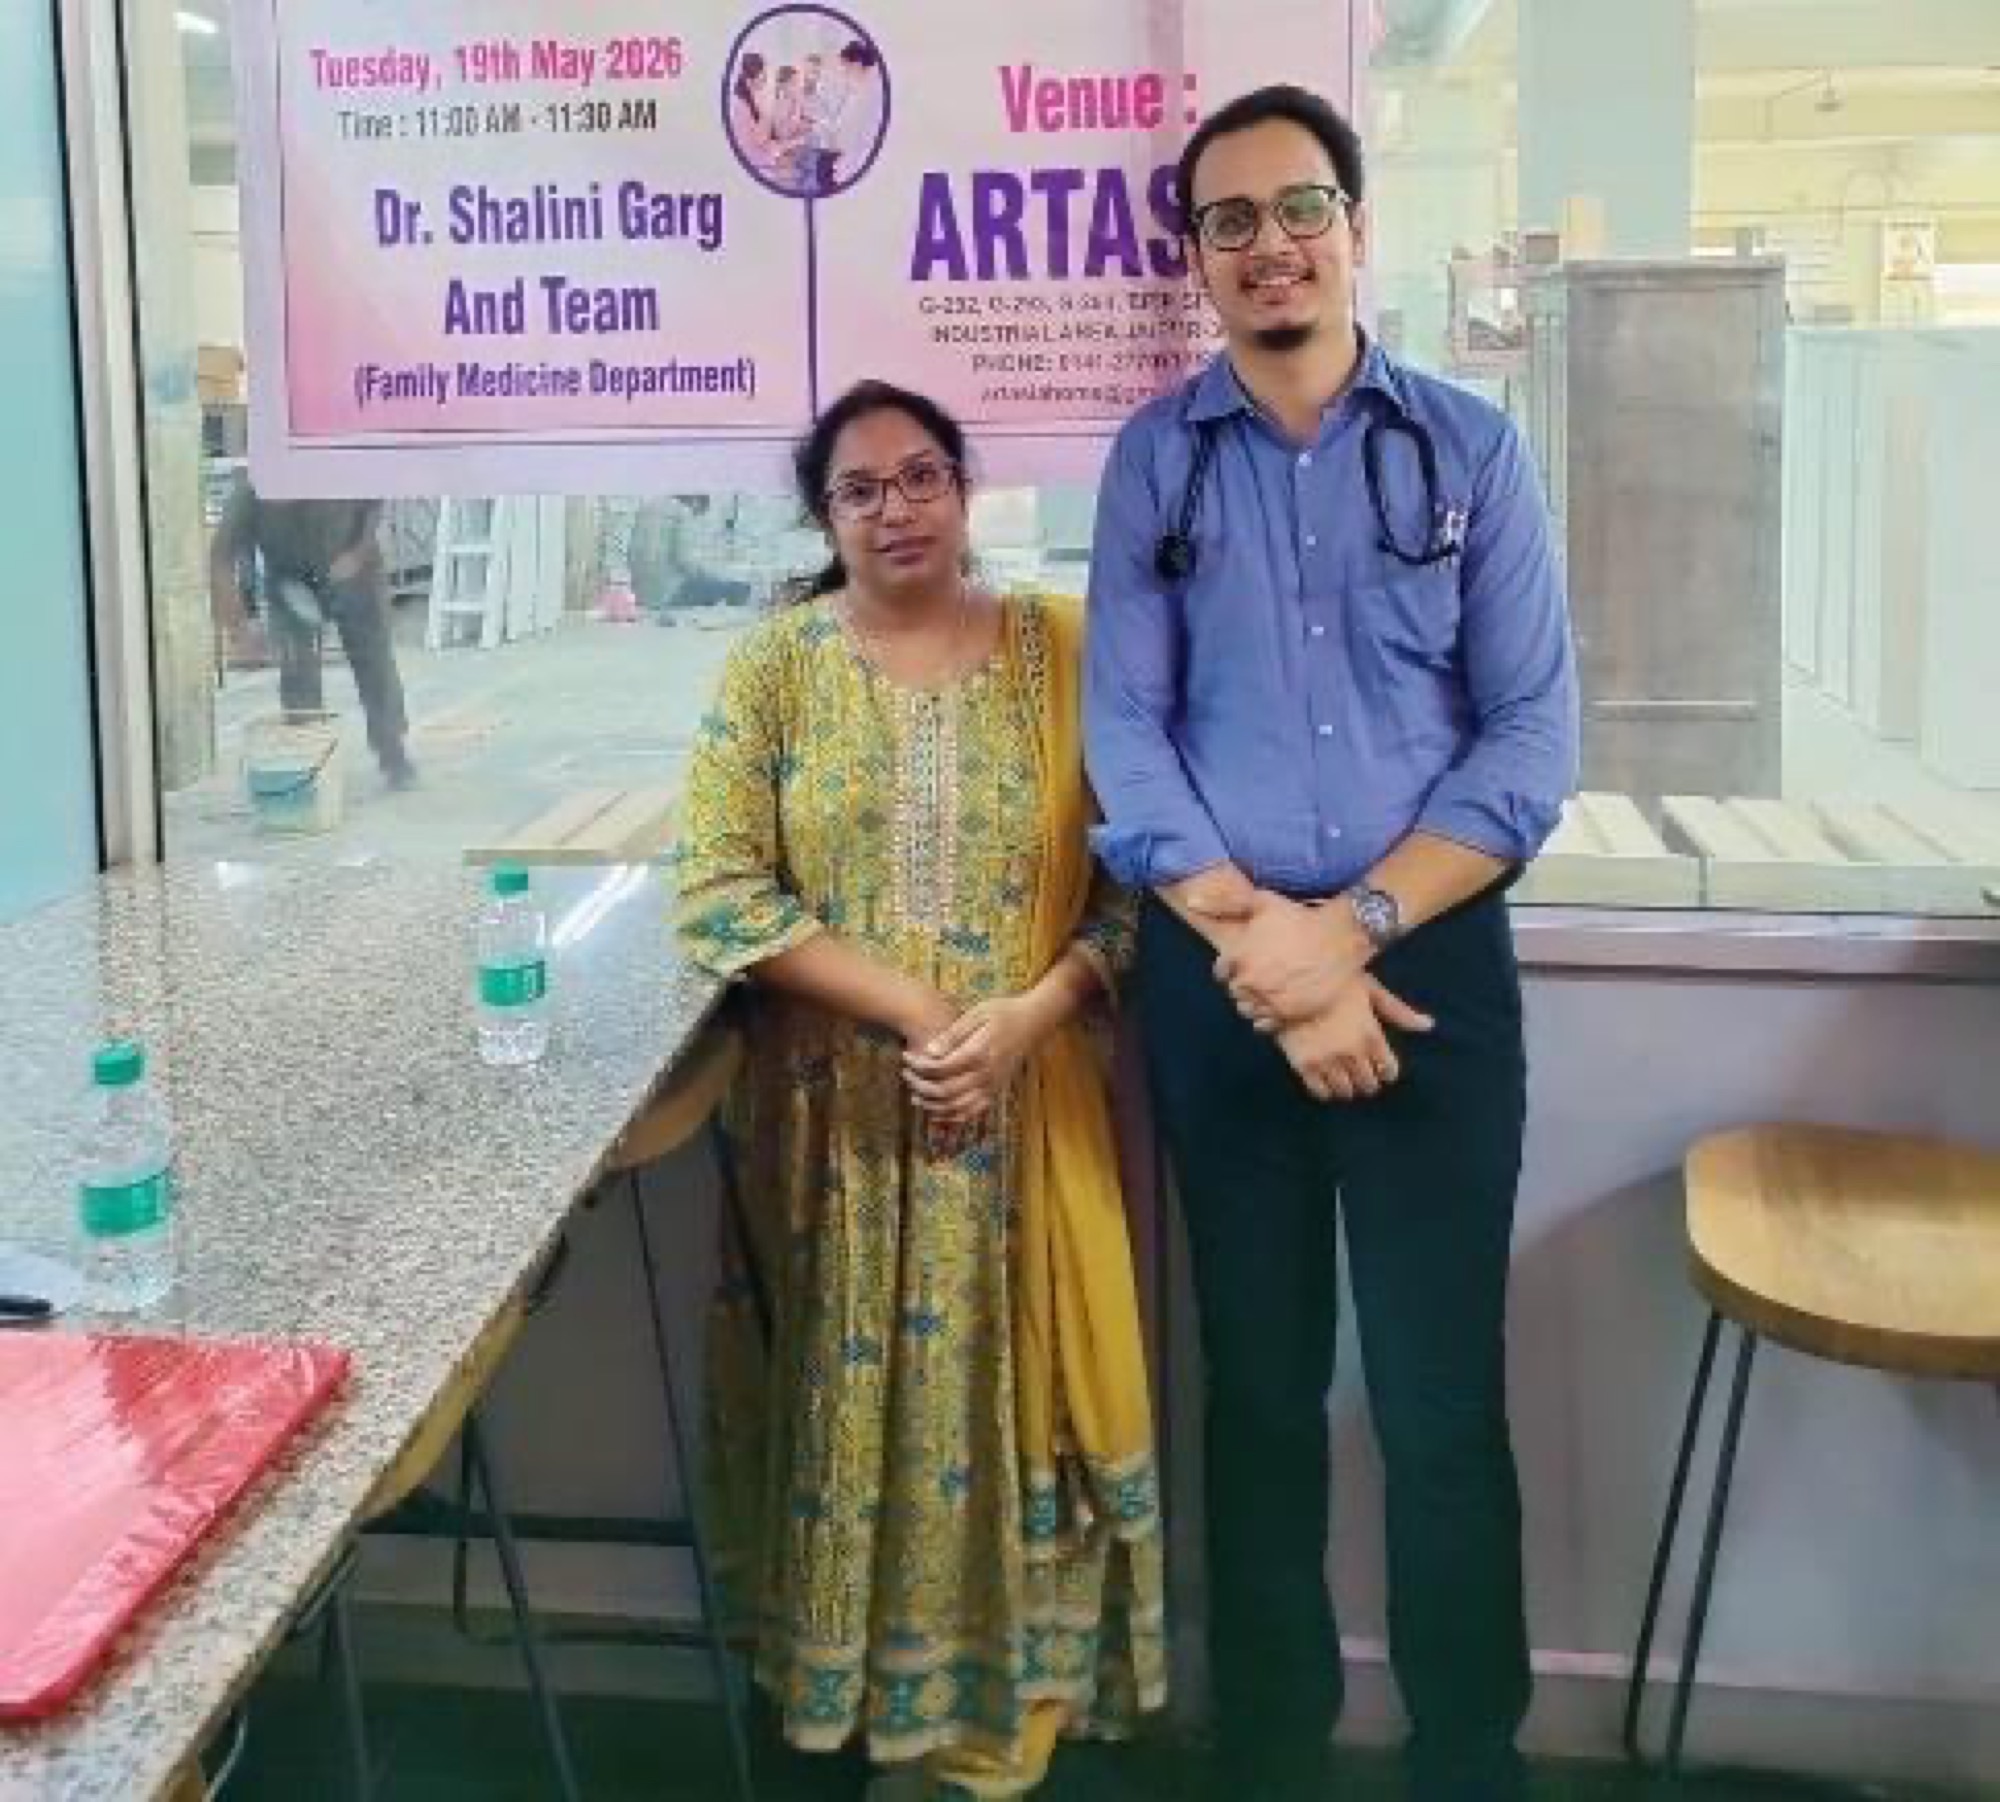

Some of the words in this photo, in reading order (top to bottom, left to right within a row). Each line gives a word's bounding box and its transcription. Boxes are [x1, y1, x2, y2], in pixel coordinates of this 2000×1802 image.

[309, 46, 443, 91] Tuesday,
[455, 40, 521, 83] 19th
[531, 39, 595, 87] May
[605, 37, 683, 79] 2026
[337, 110, 393, 139] Time
[415, 106, 480, 137] 11:00
[485, 102, 521, 133] AM
[546, 101, 612, 133] 11:30
[617, 98, 657, 130] AM
[998, 65, 1164, 132] Venue
[374, 188, 434, 248] Dr.
[448, 181, 603, 244] Shalini
[617, 180, 723, 252] Garg
[444, 276, 525, 335] And
[539, 275, 660, 335] Team
[354, 362, 450, 409] (Family
[456, 361, 582, 398] Medicine
[588, 356, 757, 403] Department)
